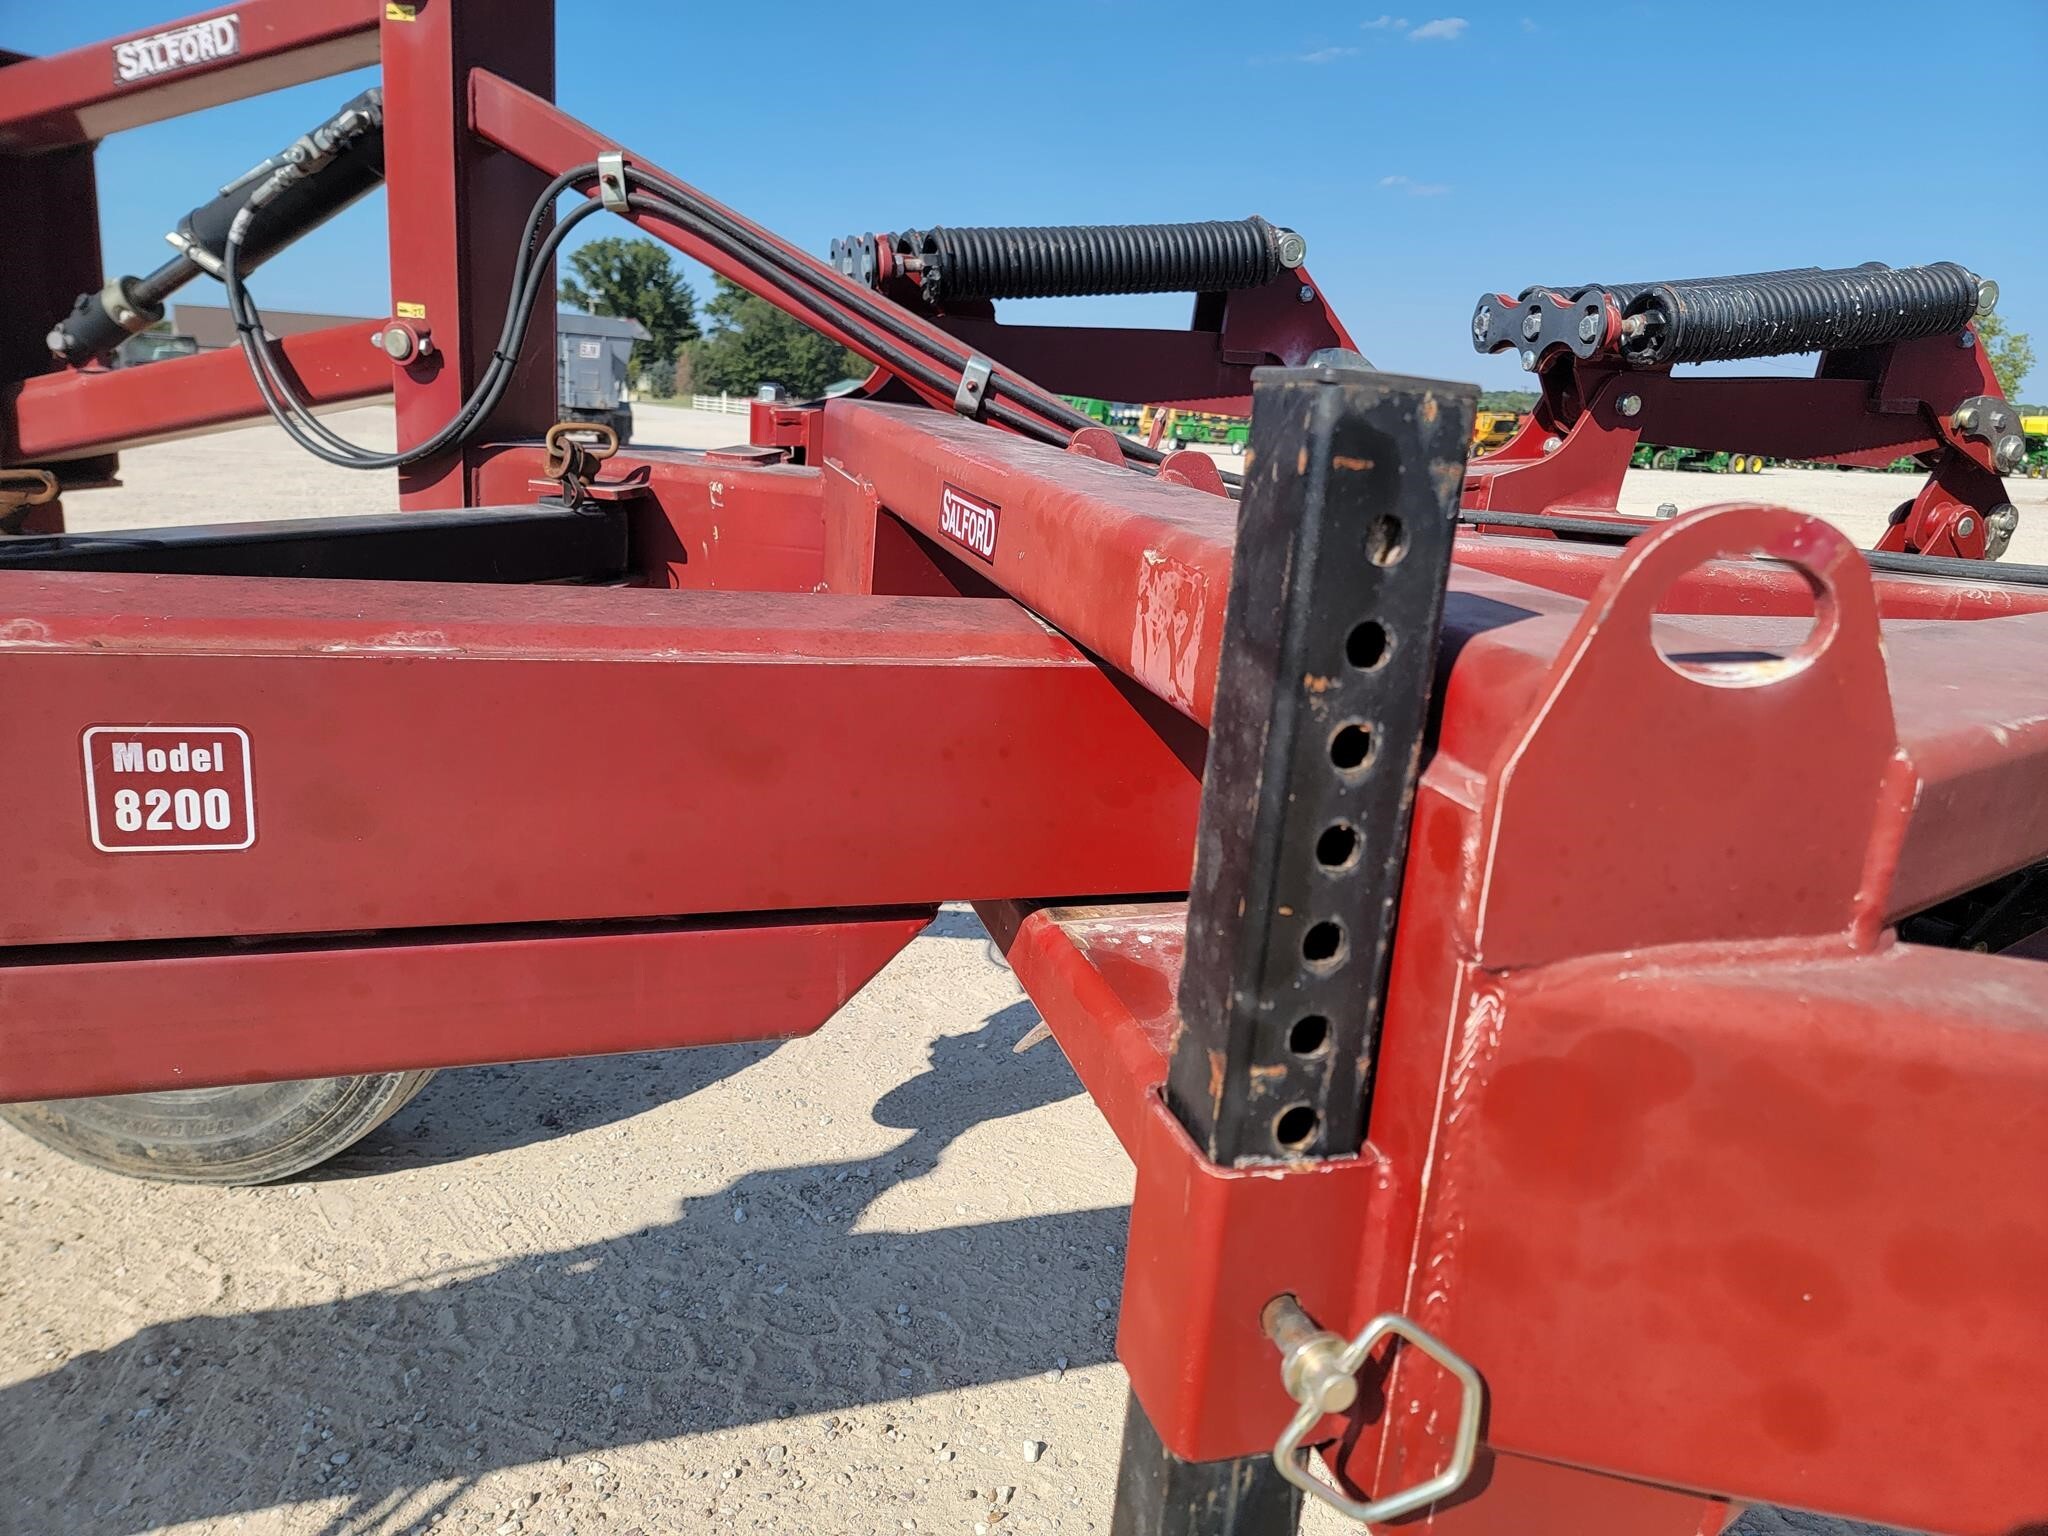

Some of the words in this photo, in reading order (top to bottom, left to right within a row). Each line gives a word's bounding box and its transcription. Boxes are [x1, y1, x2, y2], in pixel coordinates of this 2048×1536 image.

[116, 17, 236, 80] SALFORD
[942, 488, 995, 556] SALFORD
[111, 742, 224, 773] Model
[114, 788, 231, 832] 8200
